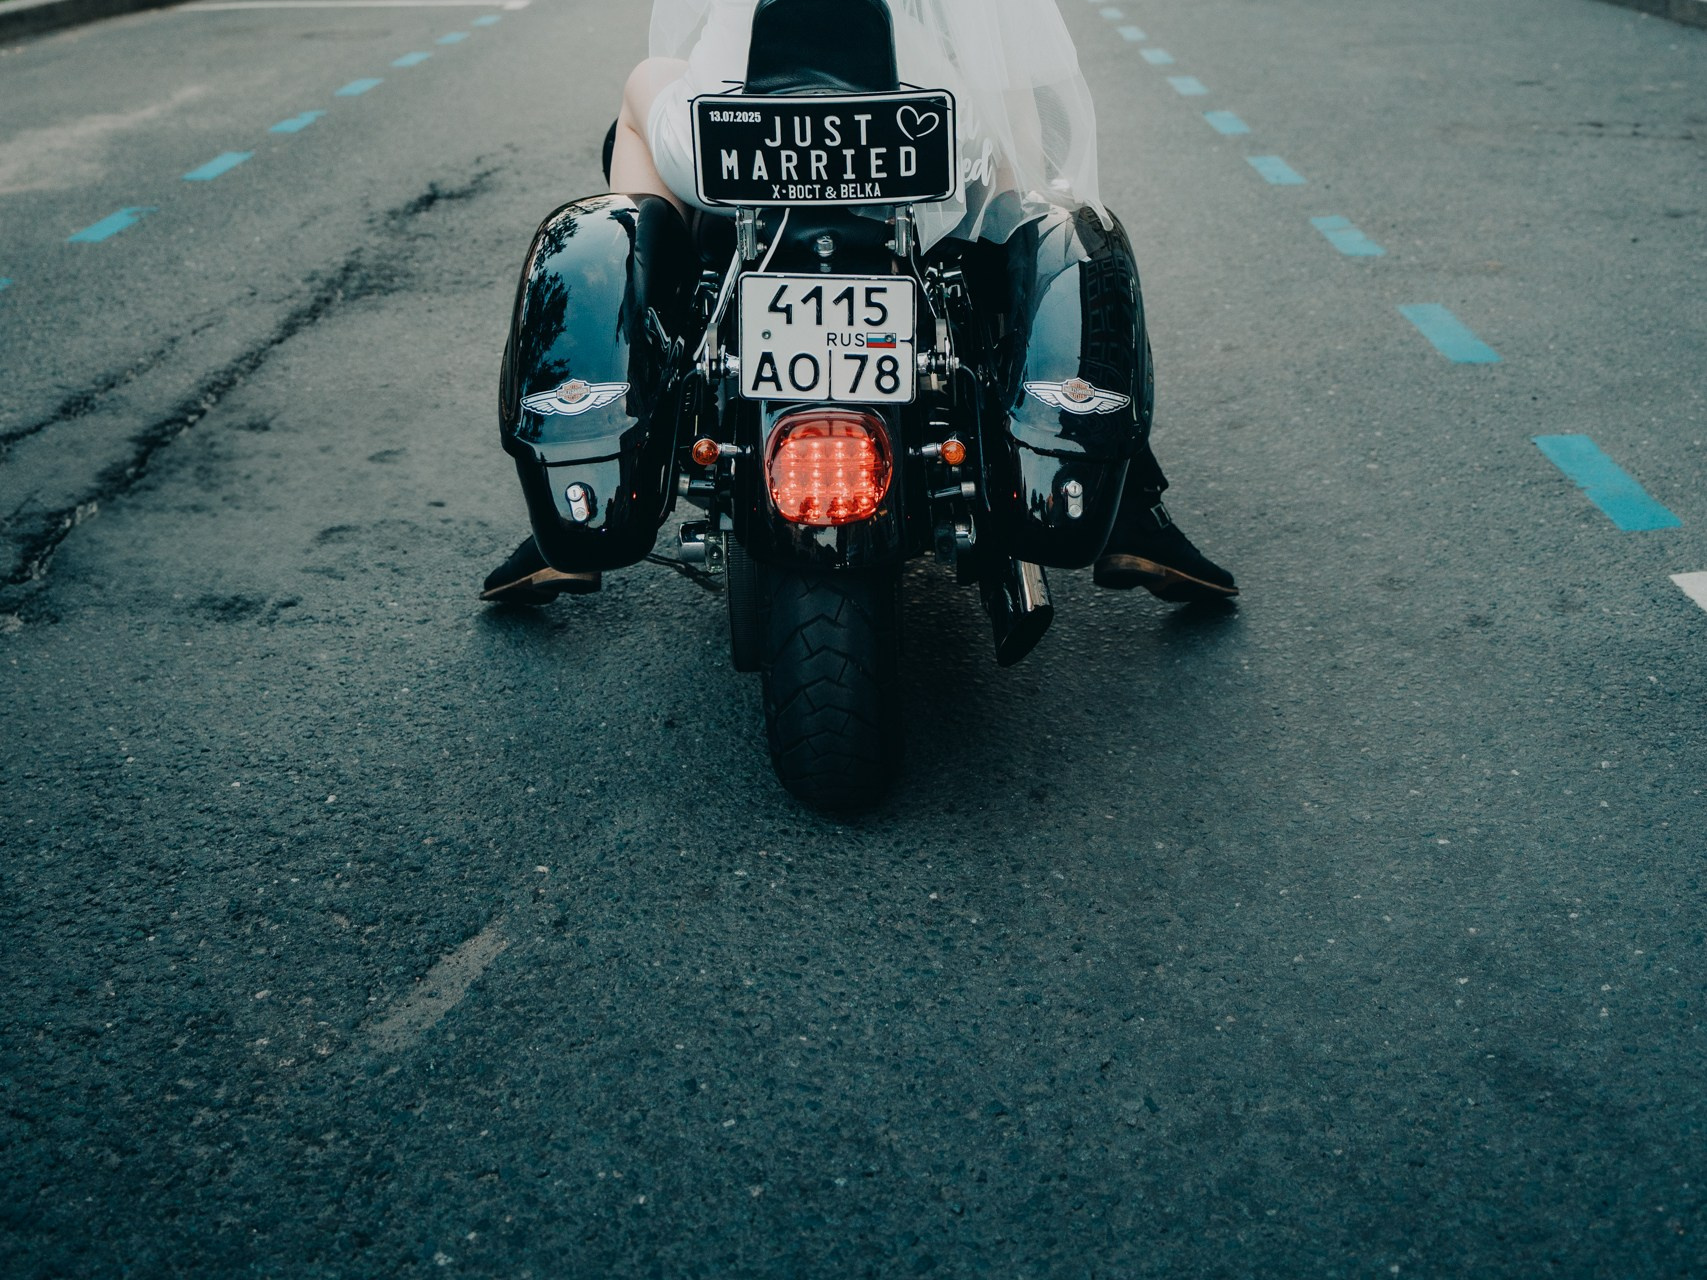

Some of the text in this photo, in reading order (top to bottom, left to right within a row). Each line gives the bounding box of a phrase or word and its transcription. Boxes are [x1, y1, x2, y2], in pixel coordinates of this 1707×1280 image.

[709, 110, 761, 123] 13.07.2025
[764, 114, 872, 147] JUST
[720, 146, 917, 180] MARRIED
[825, 186, 837, 199] &
[840, 183, 881, 198] BELKA
[768, 284, 888, 327] 4115
[826, 332, 865, 347] RUS
[751, 351, 900, 395] AO 78
